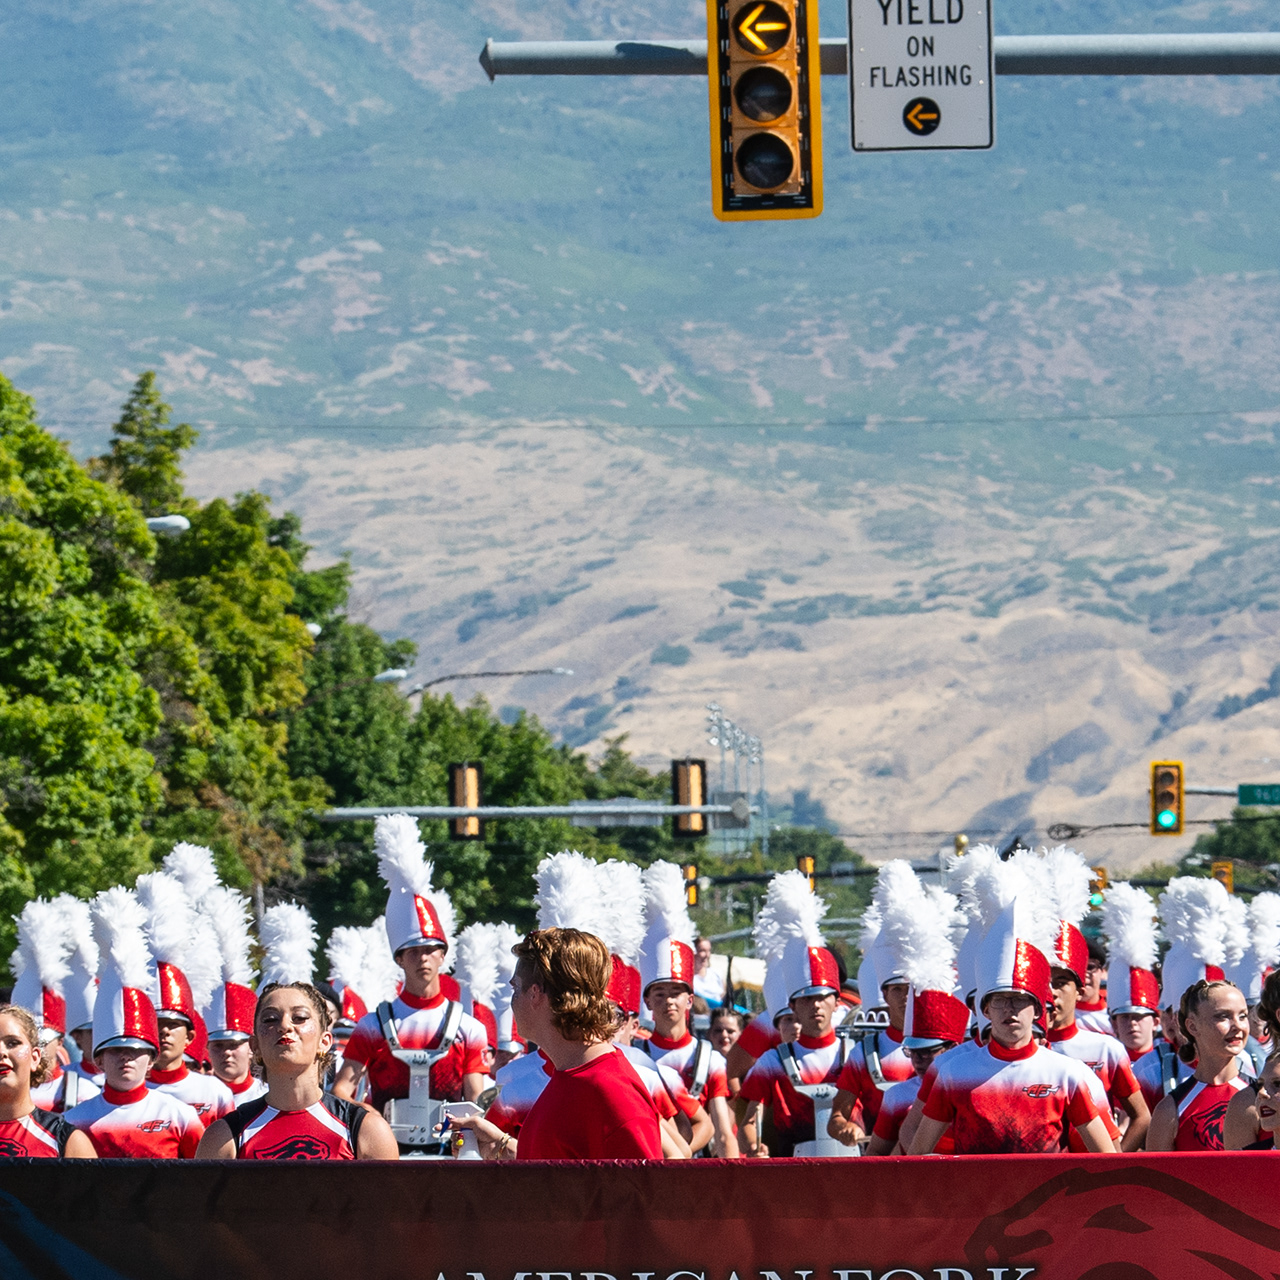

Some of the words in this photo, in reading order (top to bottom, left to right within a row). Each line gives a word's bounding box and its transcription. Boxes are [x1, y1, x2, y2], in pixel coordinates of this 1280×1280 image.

[878, 0, 964, 25] YIELD
[907, 35, 934, 57] ON
[870, 64, 972, 87] FLASHING
